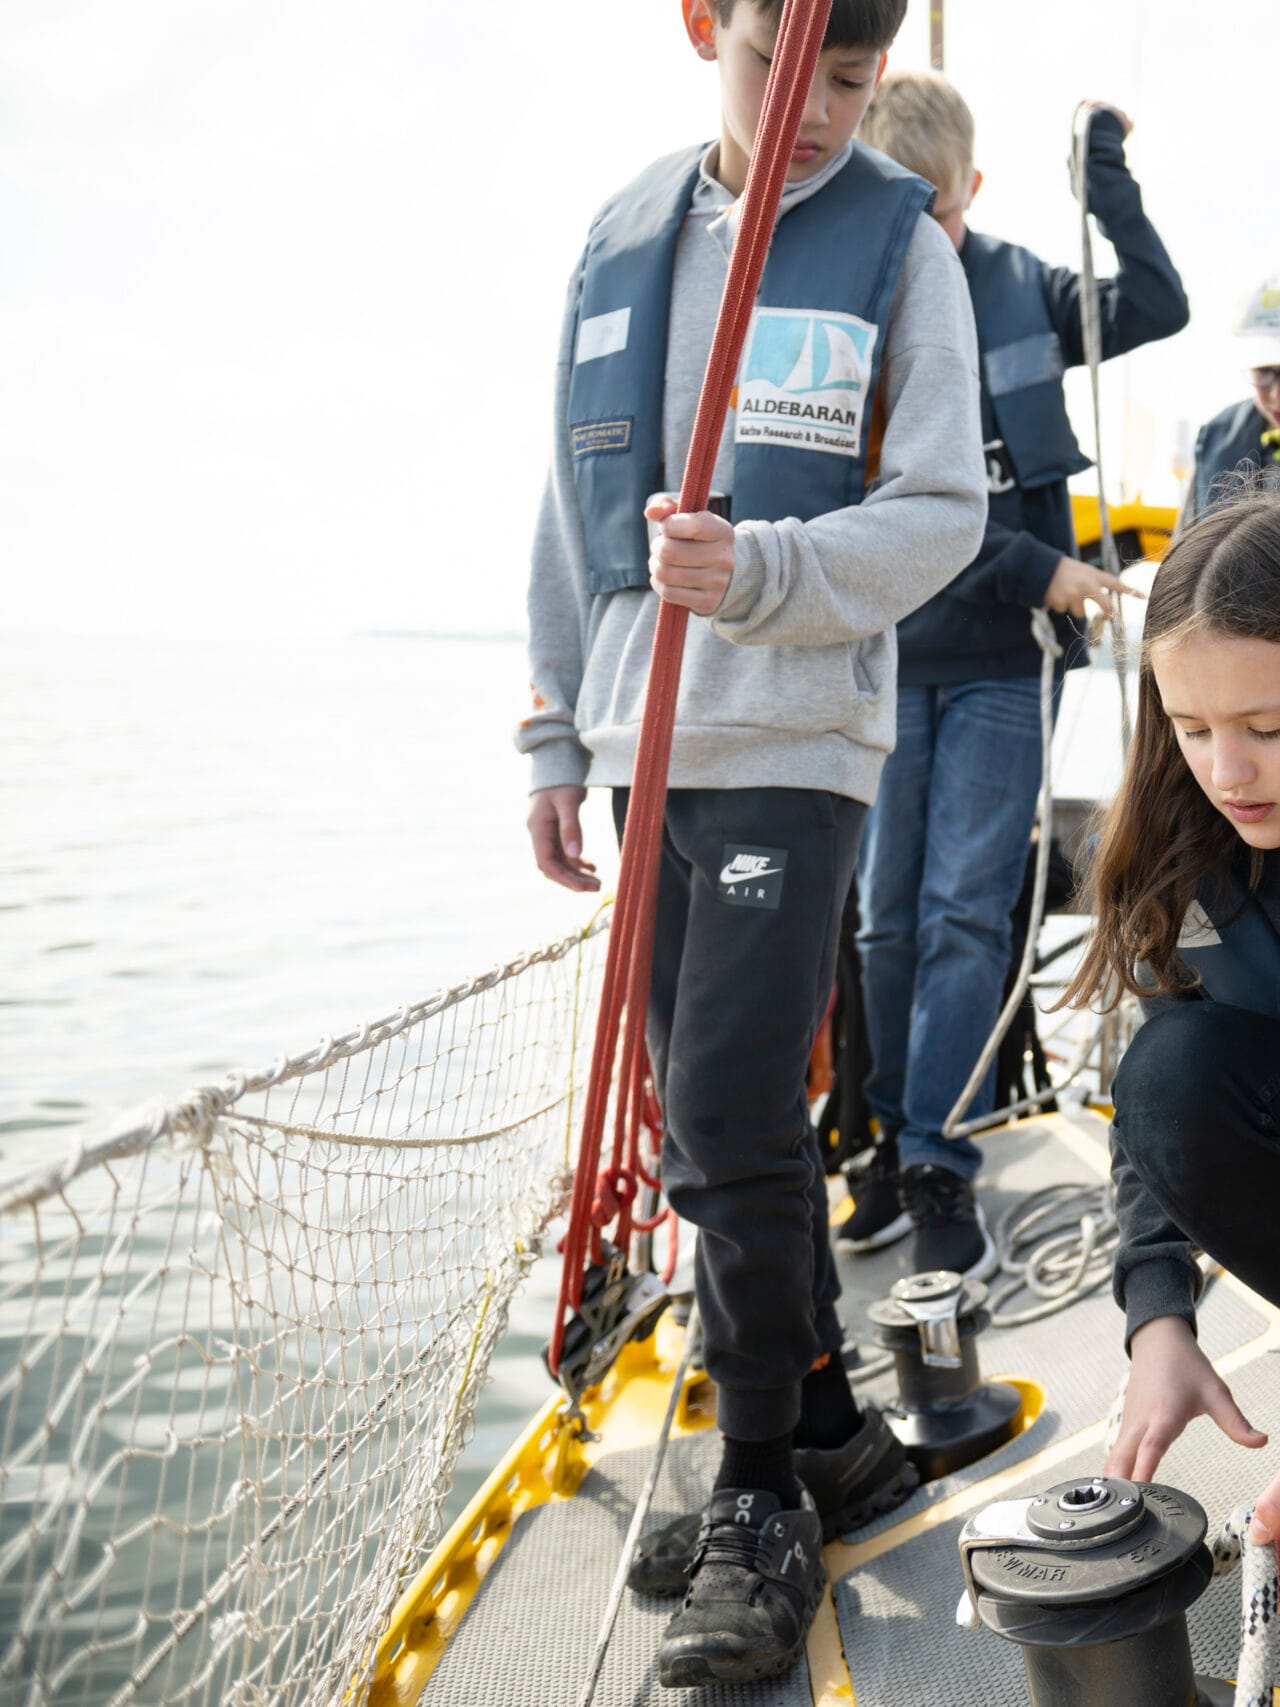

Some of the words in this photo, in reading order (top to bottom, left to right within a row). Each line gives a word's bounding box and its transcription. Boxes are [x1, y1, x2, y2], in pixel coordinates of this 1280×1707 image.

[742, 399, 857, 426] ALDEBARAN
[763, 426, 803, 440] Research
[805, 431, 811, 442] &
[814, 433, 856, 449] Broadcast
[730, 853, 771, 873] NIKE
[726, 885, 766, 899] AIR
